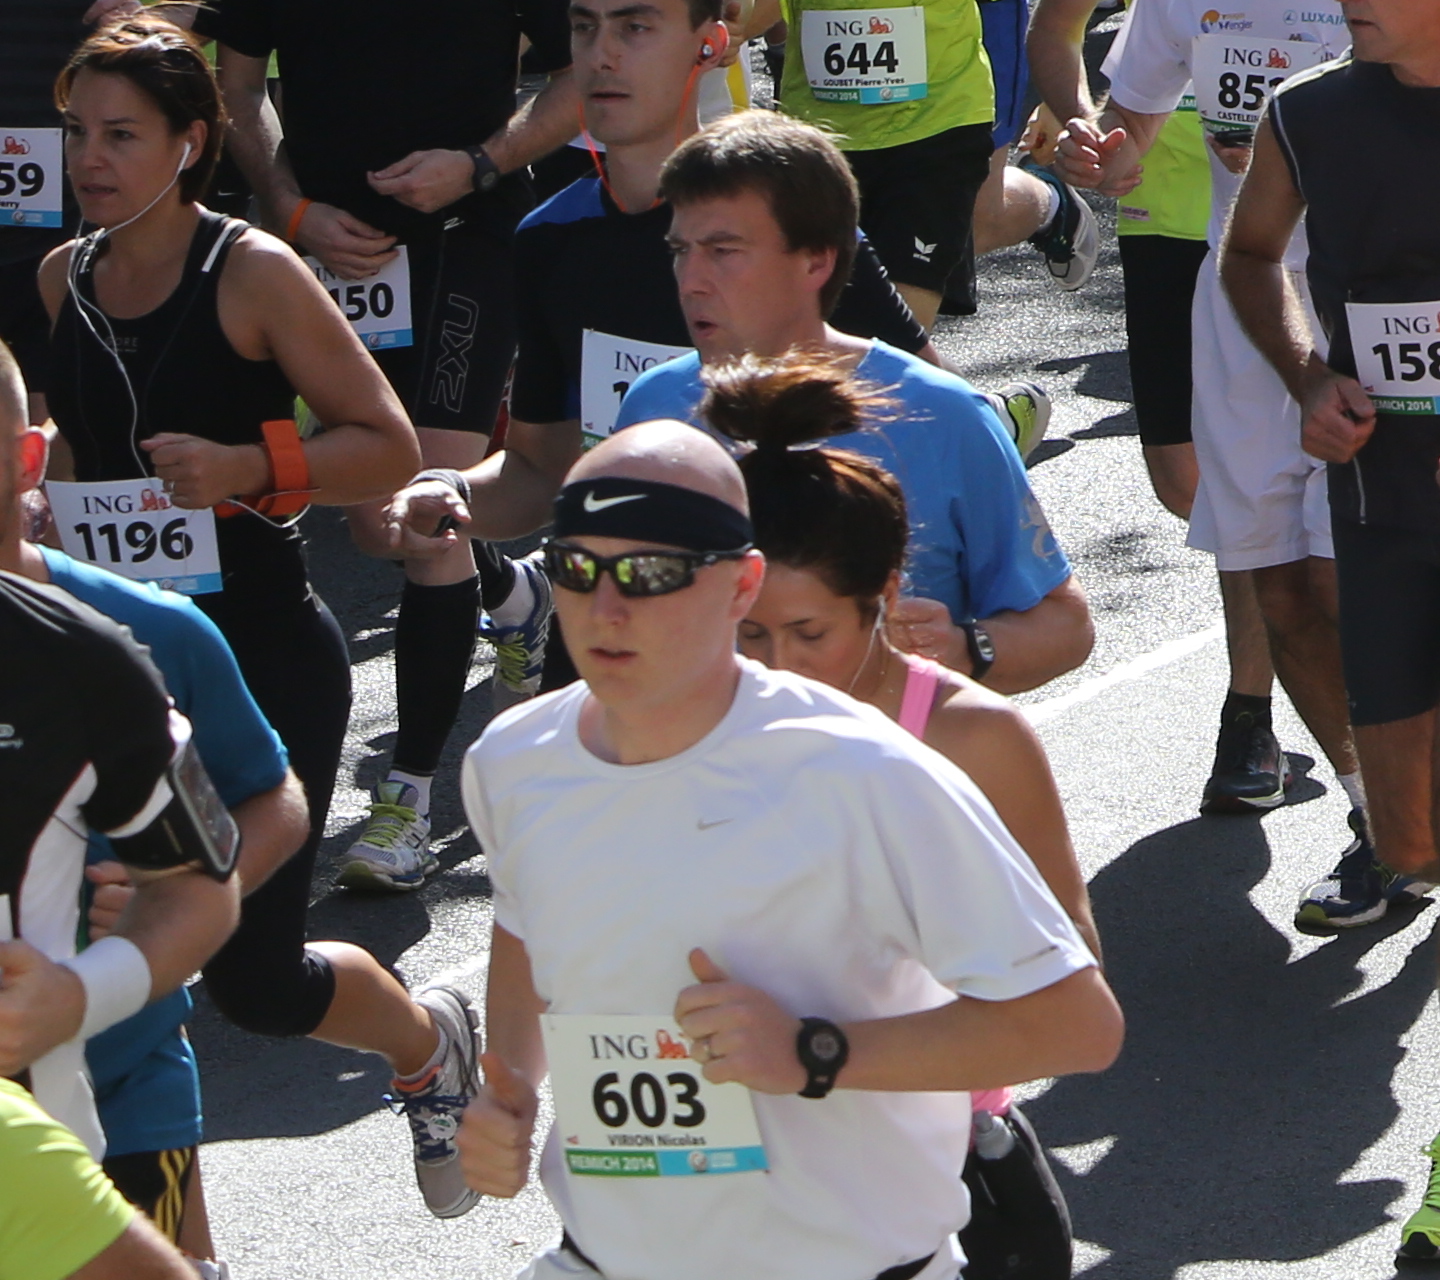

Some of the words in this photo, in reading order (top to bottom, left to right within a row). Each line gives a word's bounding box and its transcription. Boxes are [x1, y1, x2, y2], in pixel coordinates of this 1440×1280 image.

[826, 20, 863, 37] ING
[823, 41, 899, 76] 644
[1223, 46, 1262, 66] ING
[823, 78, 853, 87] GOUBET
[855, 77, 905, 87] Pierre-Yves
[839, 91, 858, 101] 2014
[1382, 314, 1431, 336] ING
[1408, 398, 1432, 412] 2014
[82, 494, 134, 515] ING
[74, 518, 194, 563] 1196
[591, 1033, 648, 1059] ING
[591, 1071, 707, 1127] 603
[607, 1134, 653, 1148] VIRION
[655, 1133, 707, 1147] Nicolas
[570, 1153, 620, 1173] REMICH
[621, 1154, 656, 1172] 2014
